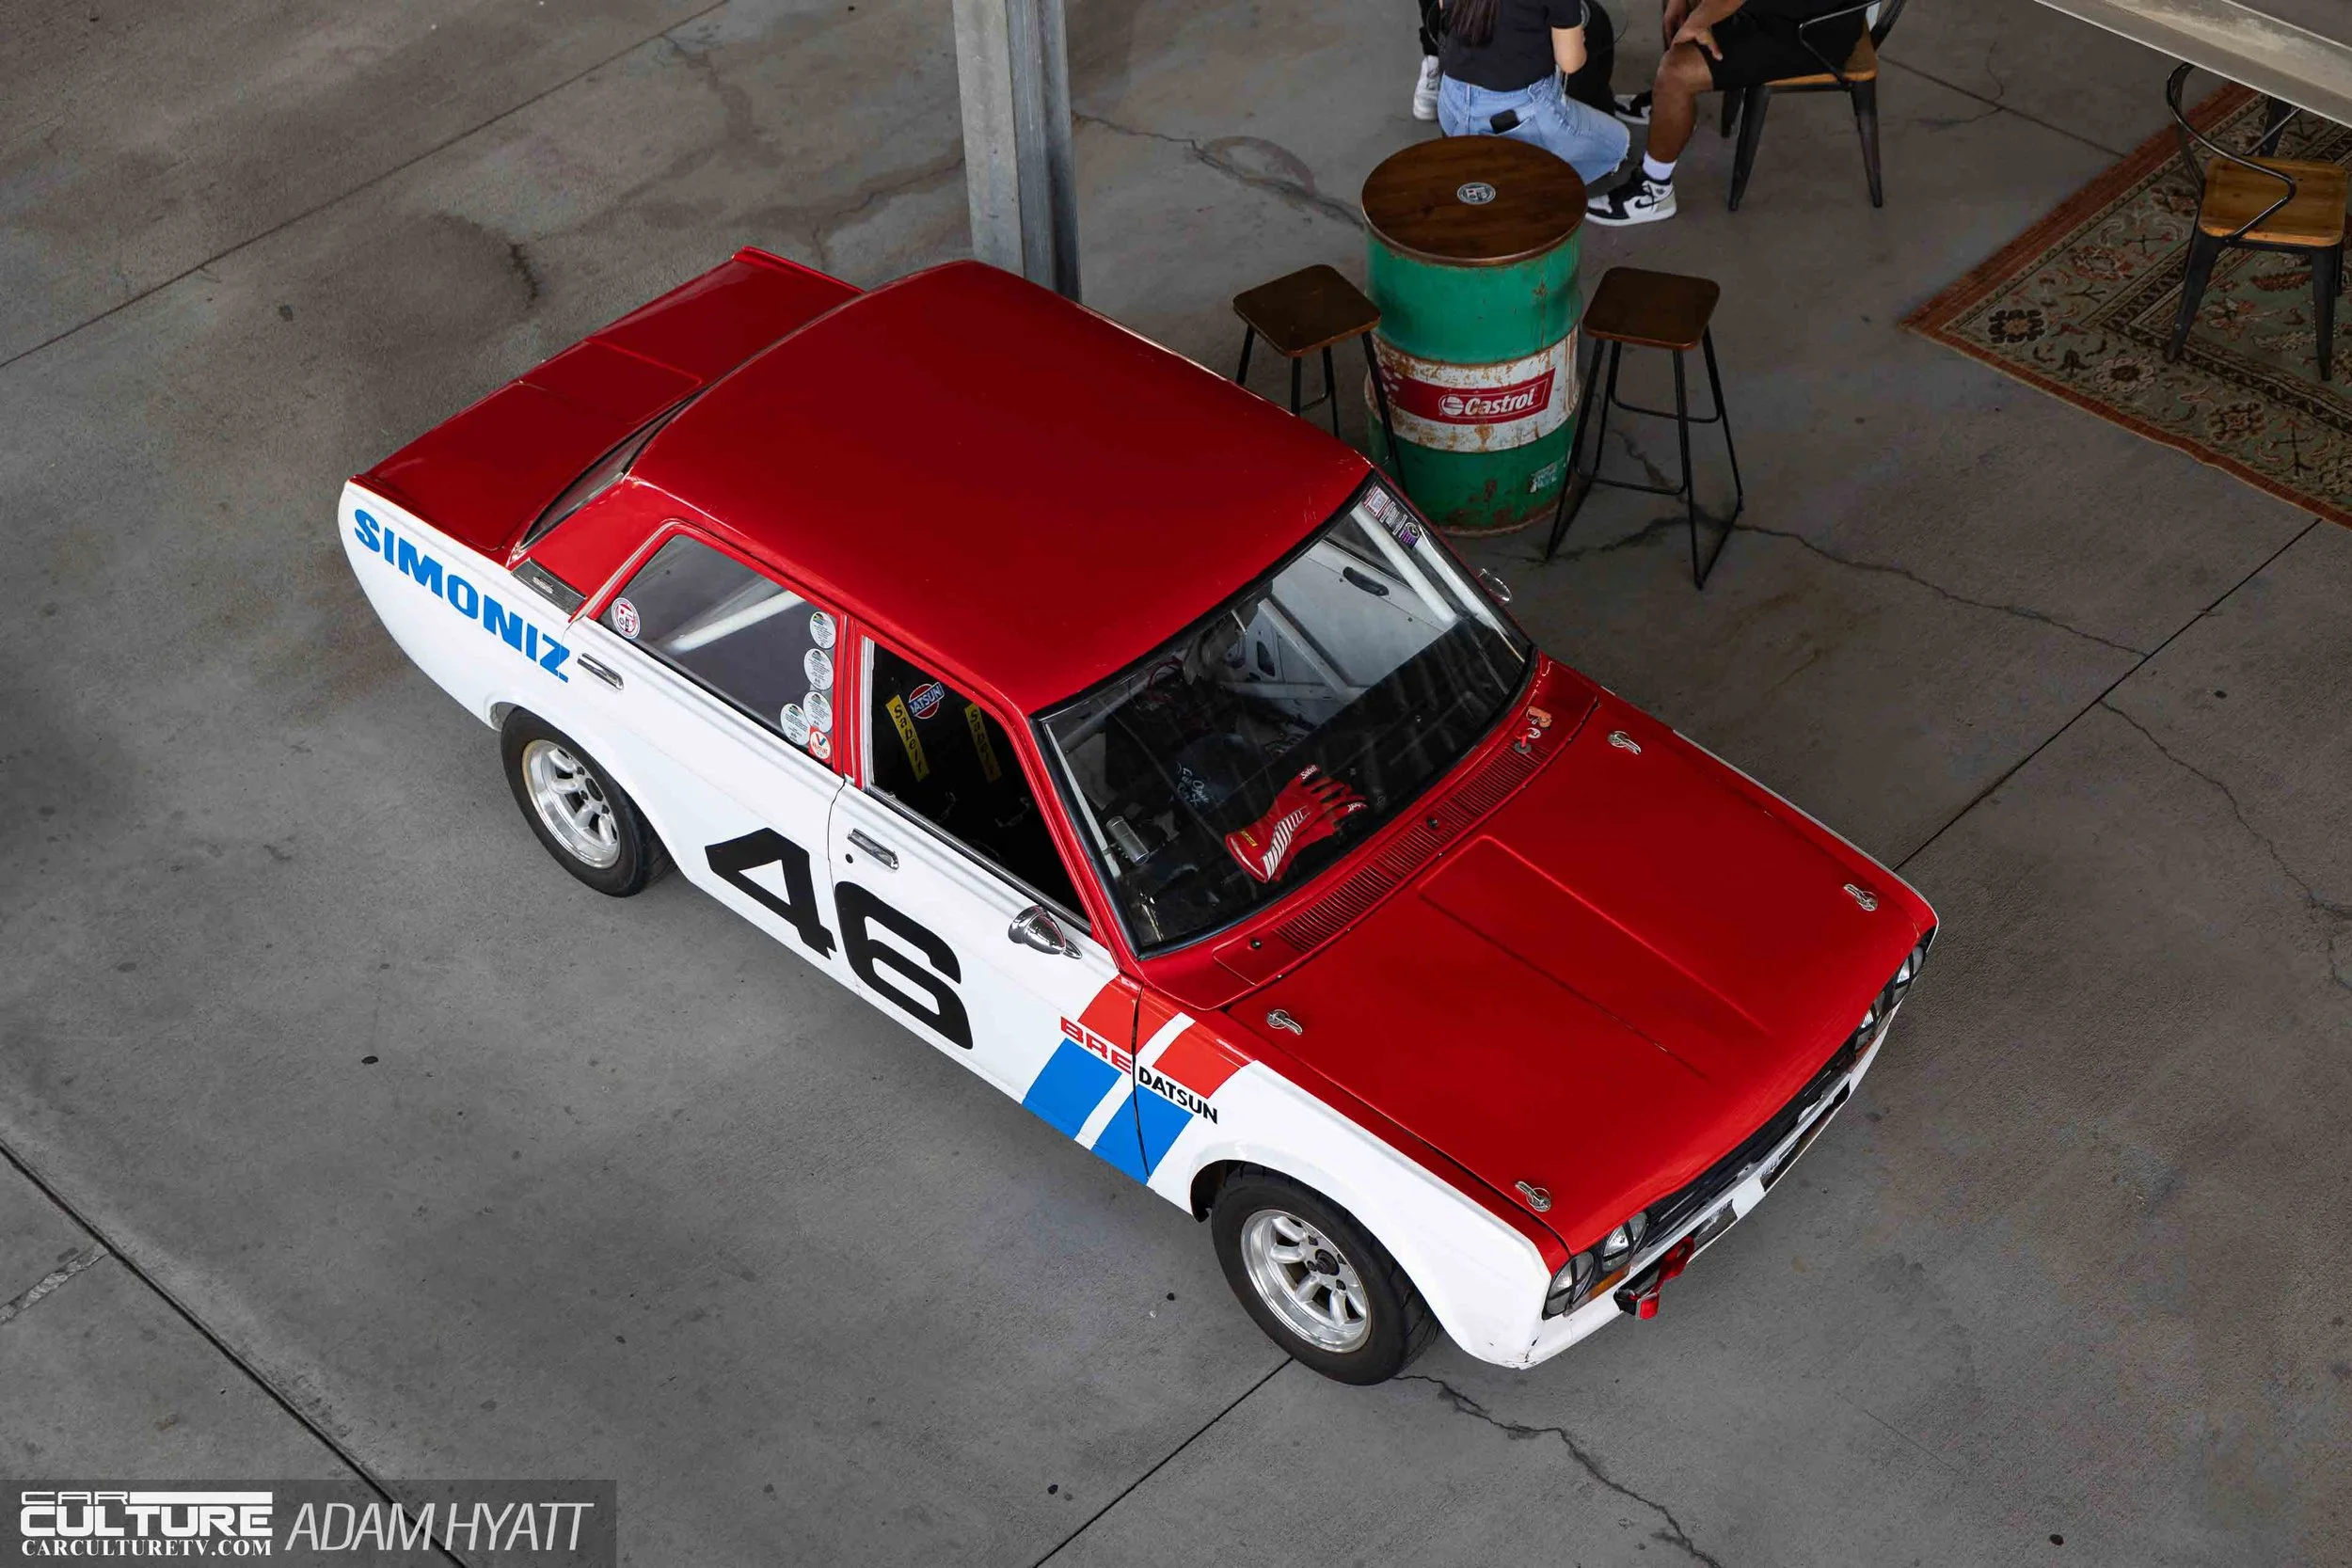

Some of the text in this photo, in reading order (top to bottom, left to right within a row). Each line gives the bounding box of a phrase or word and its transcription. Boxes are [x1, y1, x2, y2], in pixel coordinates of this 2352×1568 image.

[1465, 388, 1535, 415] Castrol
[355, 509, 570, 683] SIMONIZ
[705, 827, 973, 1050] 46
[1060, 1016, 1132, 1075] BRE
[1139, 1066, 1217, 1124] DATSUN
